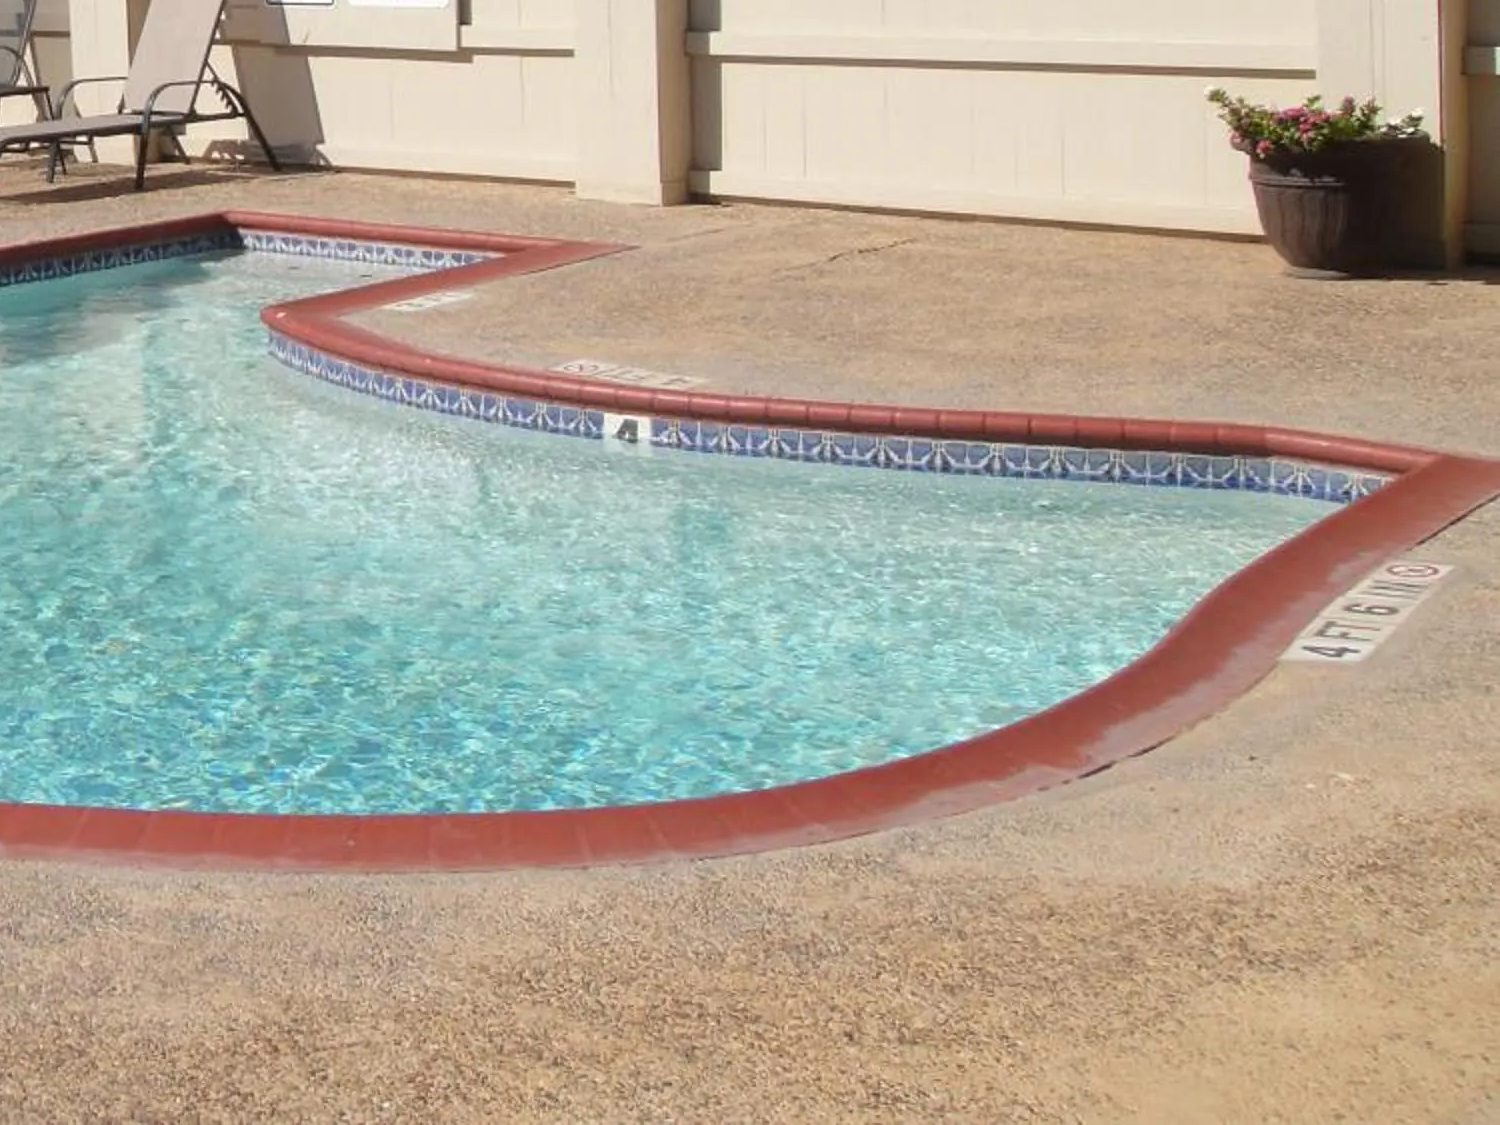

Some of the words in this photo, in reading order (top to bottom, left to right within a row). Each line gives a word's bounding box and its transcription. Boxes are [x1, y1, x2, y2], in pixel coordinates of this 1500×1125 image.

[1344, 603, 1400, 616] 6
[1314, 620, 1382, 642] FT
[1301, 645, 1361, 659] 4
